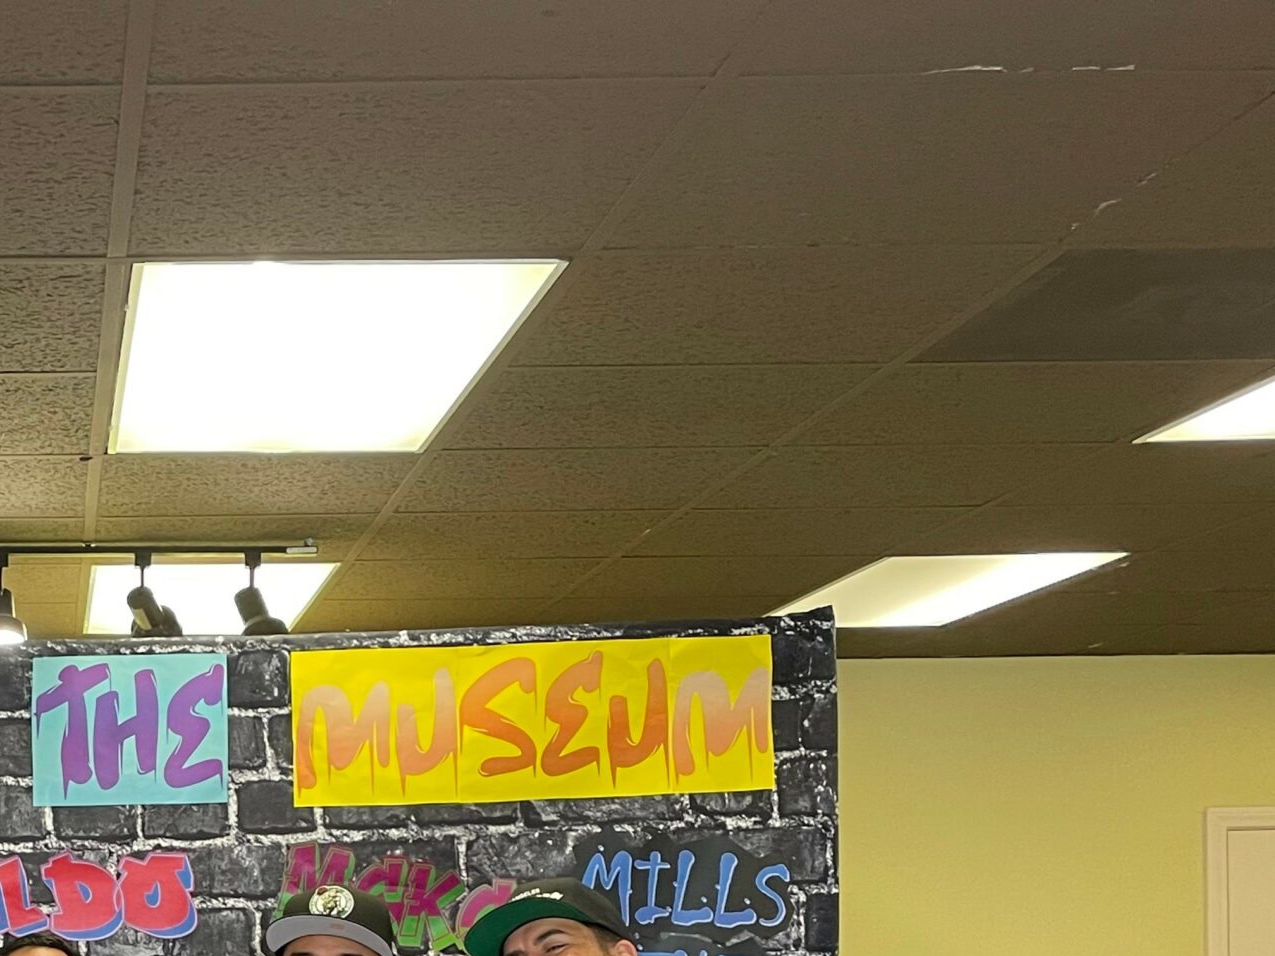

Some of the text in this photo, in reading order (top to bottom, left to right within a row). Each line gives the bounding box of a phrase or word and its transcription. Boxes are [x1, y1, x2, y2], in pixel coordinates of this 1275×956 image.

[35, 662, 227, 801] THE
[296, 650, 771, 798] MUSEUM
[582, 849, 791, 929] MILLS
